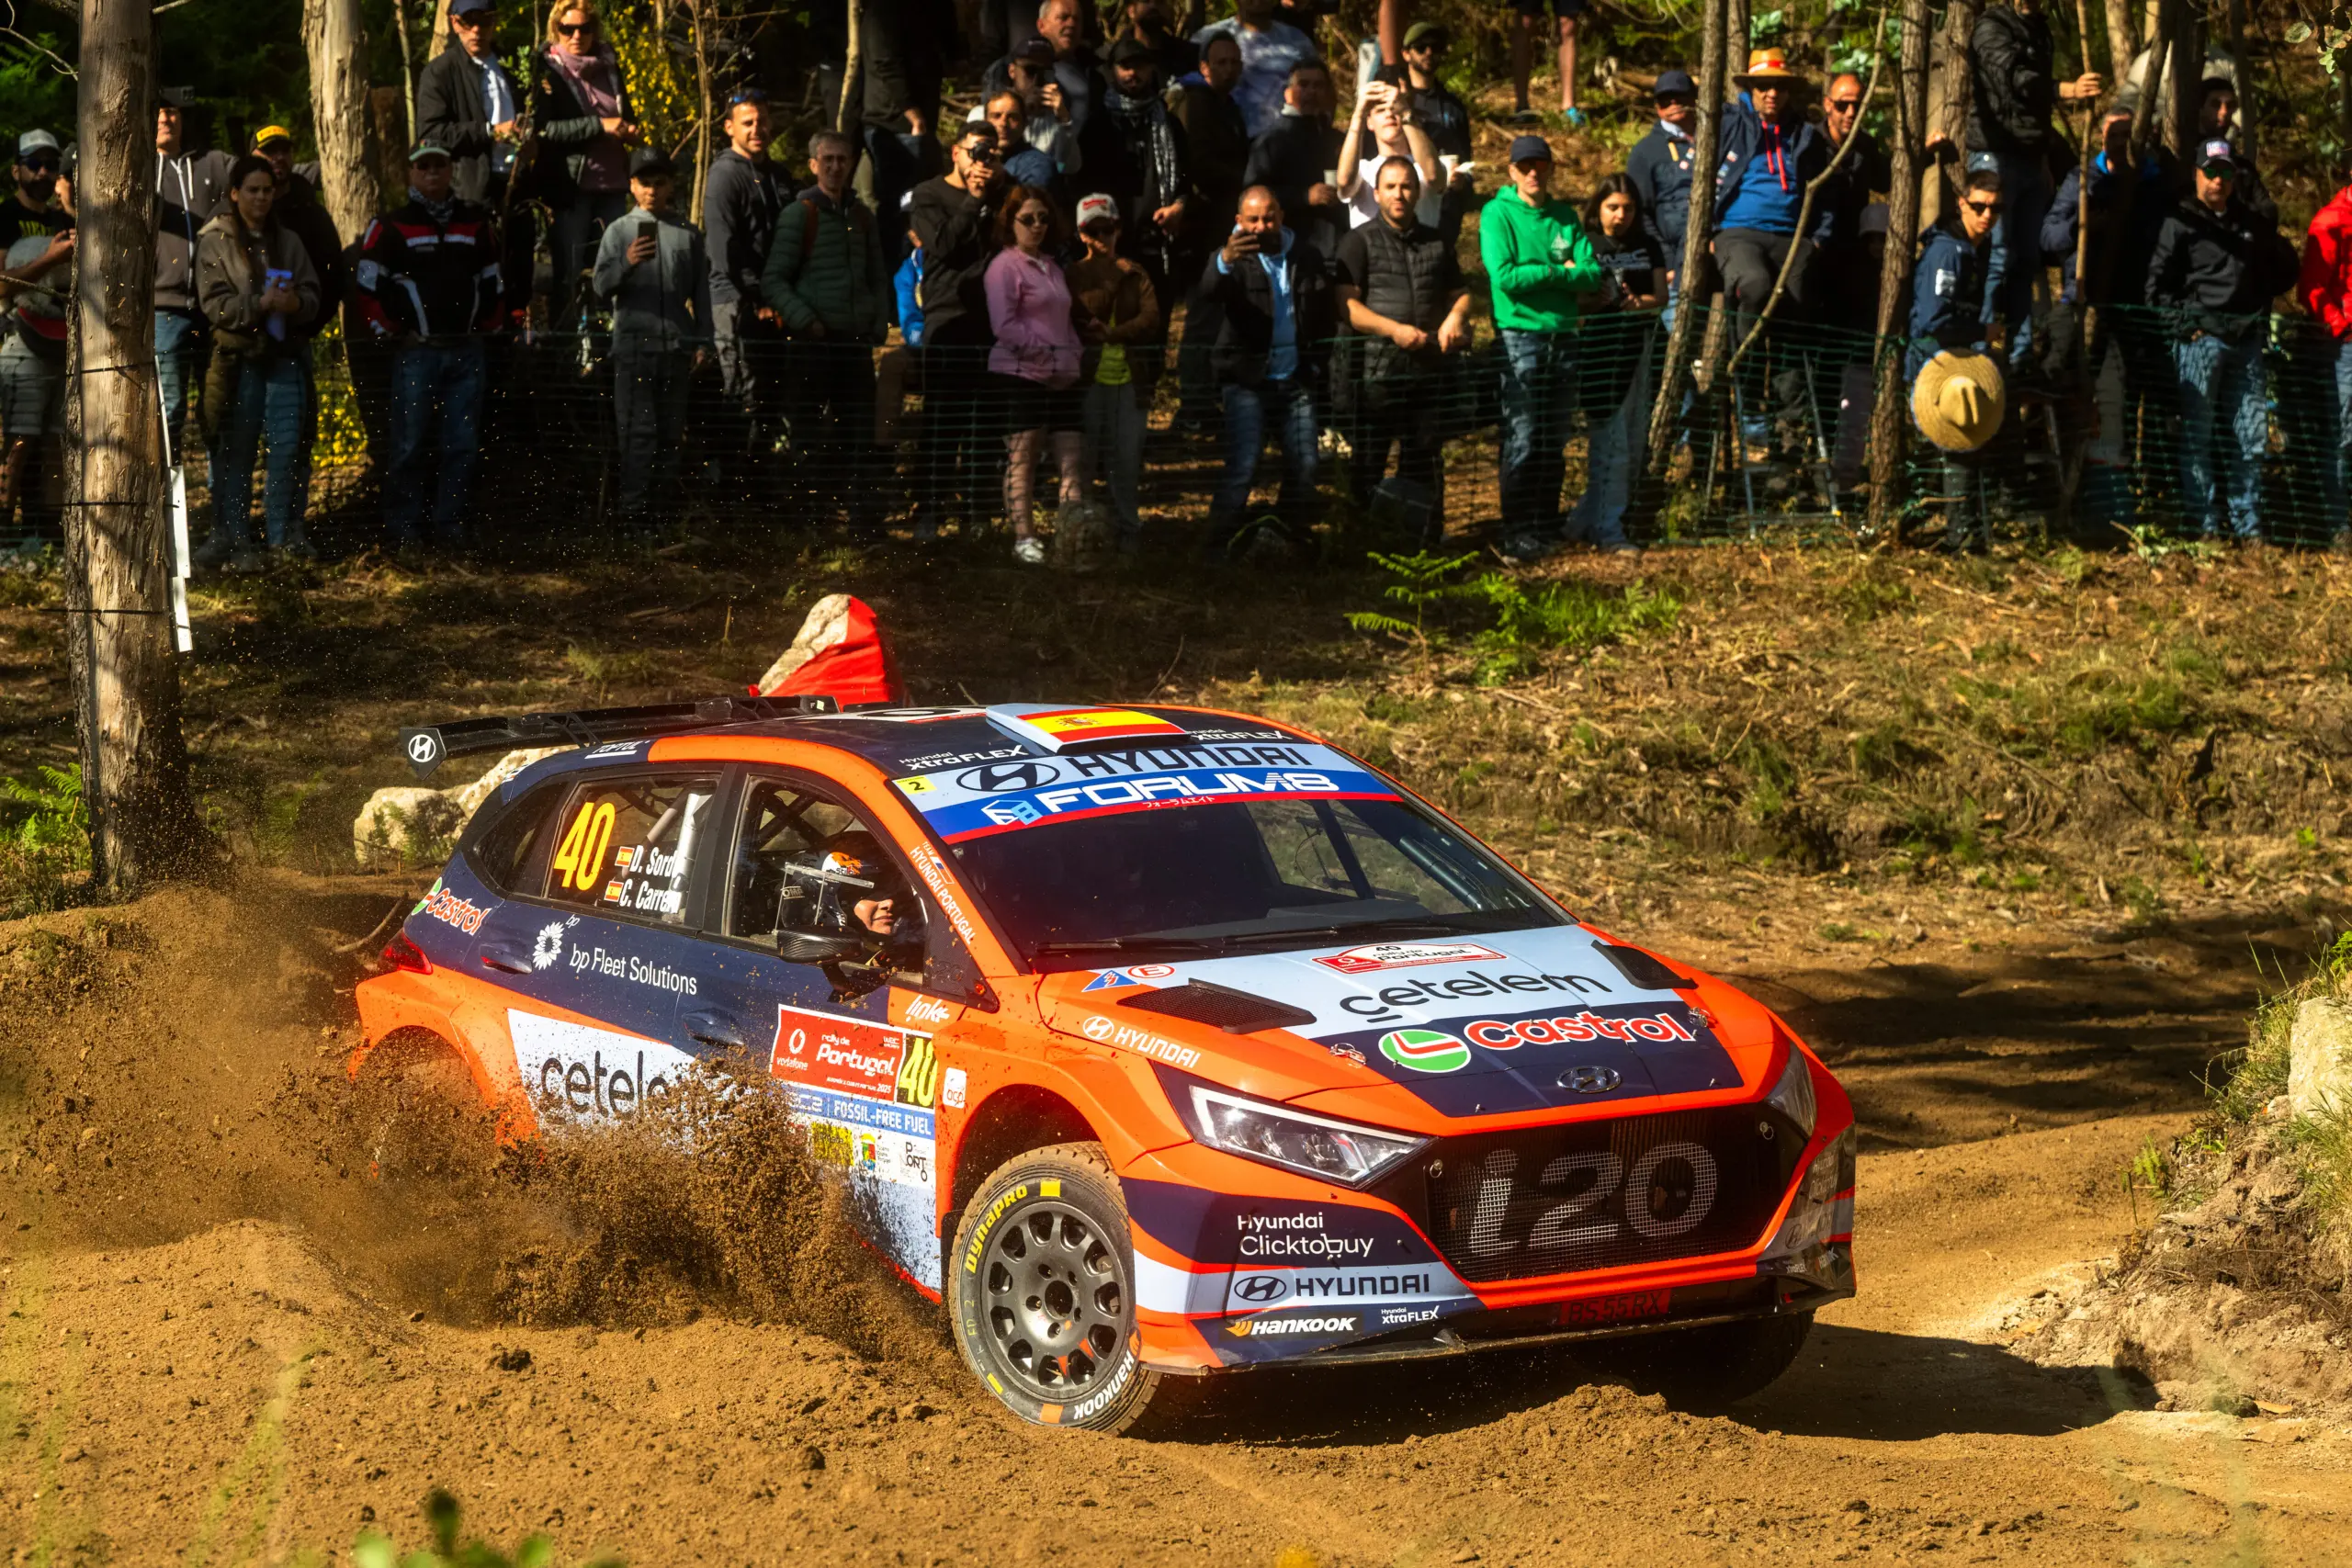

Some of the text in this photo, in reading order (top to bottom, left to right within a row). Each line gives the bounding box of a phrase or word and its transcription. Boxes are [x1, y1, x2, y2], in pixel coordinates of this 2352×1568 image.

[899, 751, 954, 765] Hyundai
[905, 744, 1029, 771] xtraFLEX
[1064, 745, 1313, 778] HYUNDAI
[909, 781, 925, 791] 2
[1035, 772, 1340, 813] FORUM8
[553, 802, 616, 891] 40
[629, 844, 644, 874] D.
[922, 841, 935, 855] TEAM
[619, 878, 633, 907] C.
[910, 846, 944, 893] HYUNDAI
[937, 886, 977, 945] PORTUGAL
[425, 887, 492, 936] Castrol
[565, 914, 581, 929] bp
[570, 943, 697, 996] bp Fleet Solutions
[1340, 970, 1613, 1017] cetelem
[821, 1034, 851, 1046] rally de
[1464, 1010, 1697, 1051] Castrol
[816, 1043, 896, 1077] Portugal
[1114, 1026, 1202, 1068] HYUNDAI
[776, 1056, 808, 1071] vodafone
[899, 1037, 938, 1107] 40
[876, 1083, 892, 1094] 2025
[834, 1100, 902, 1131] FOSSIL-FREE
[904, 1114, 932, 1136] FUEL
[1238, 1212, 1324, 1232] Hyundai
[1240, 1233, 1374, 1258] Clicktobuy
[1295, 1273, 1430, 1297] HYUNDAI
[1381, 1306, 1407, 1315] Hyundai
[1382, 1304, 1440, 1325] xtraFLEX
